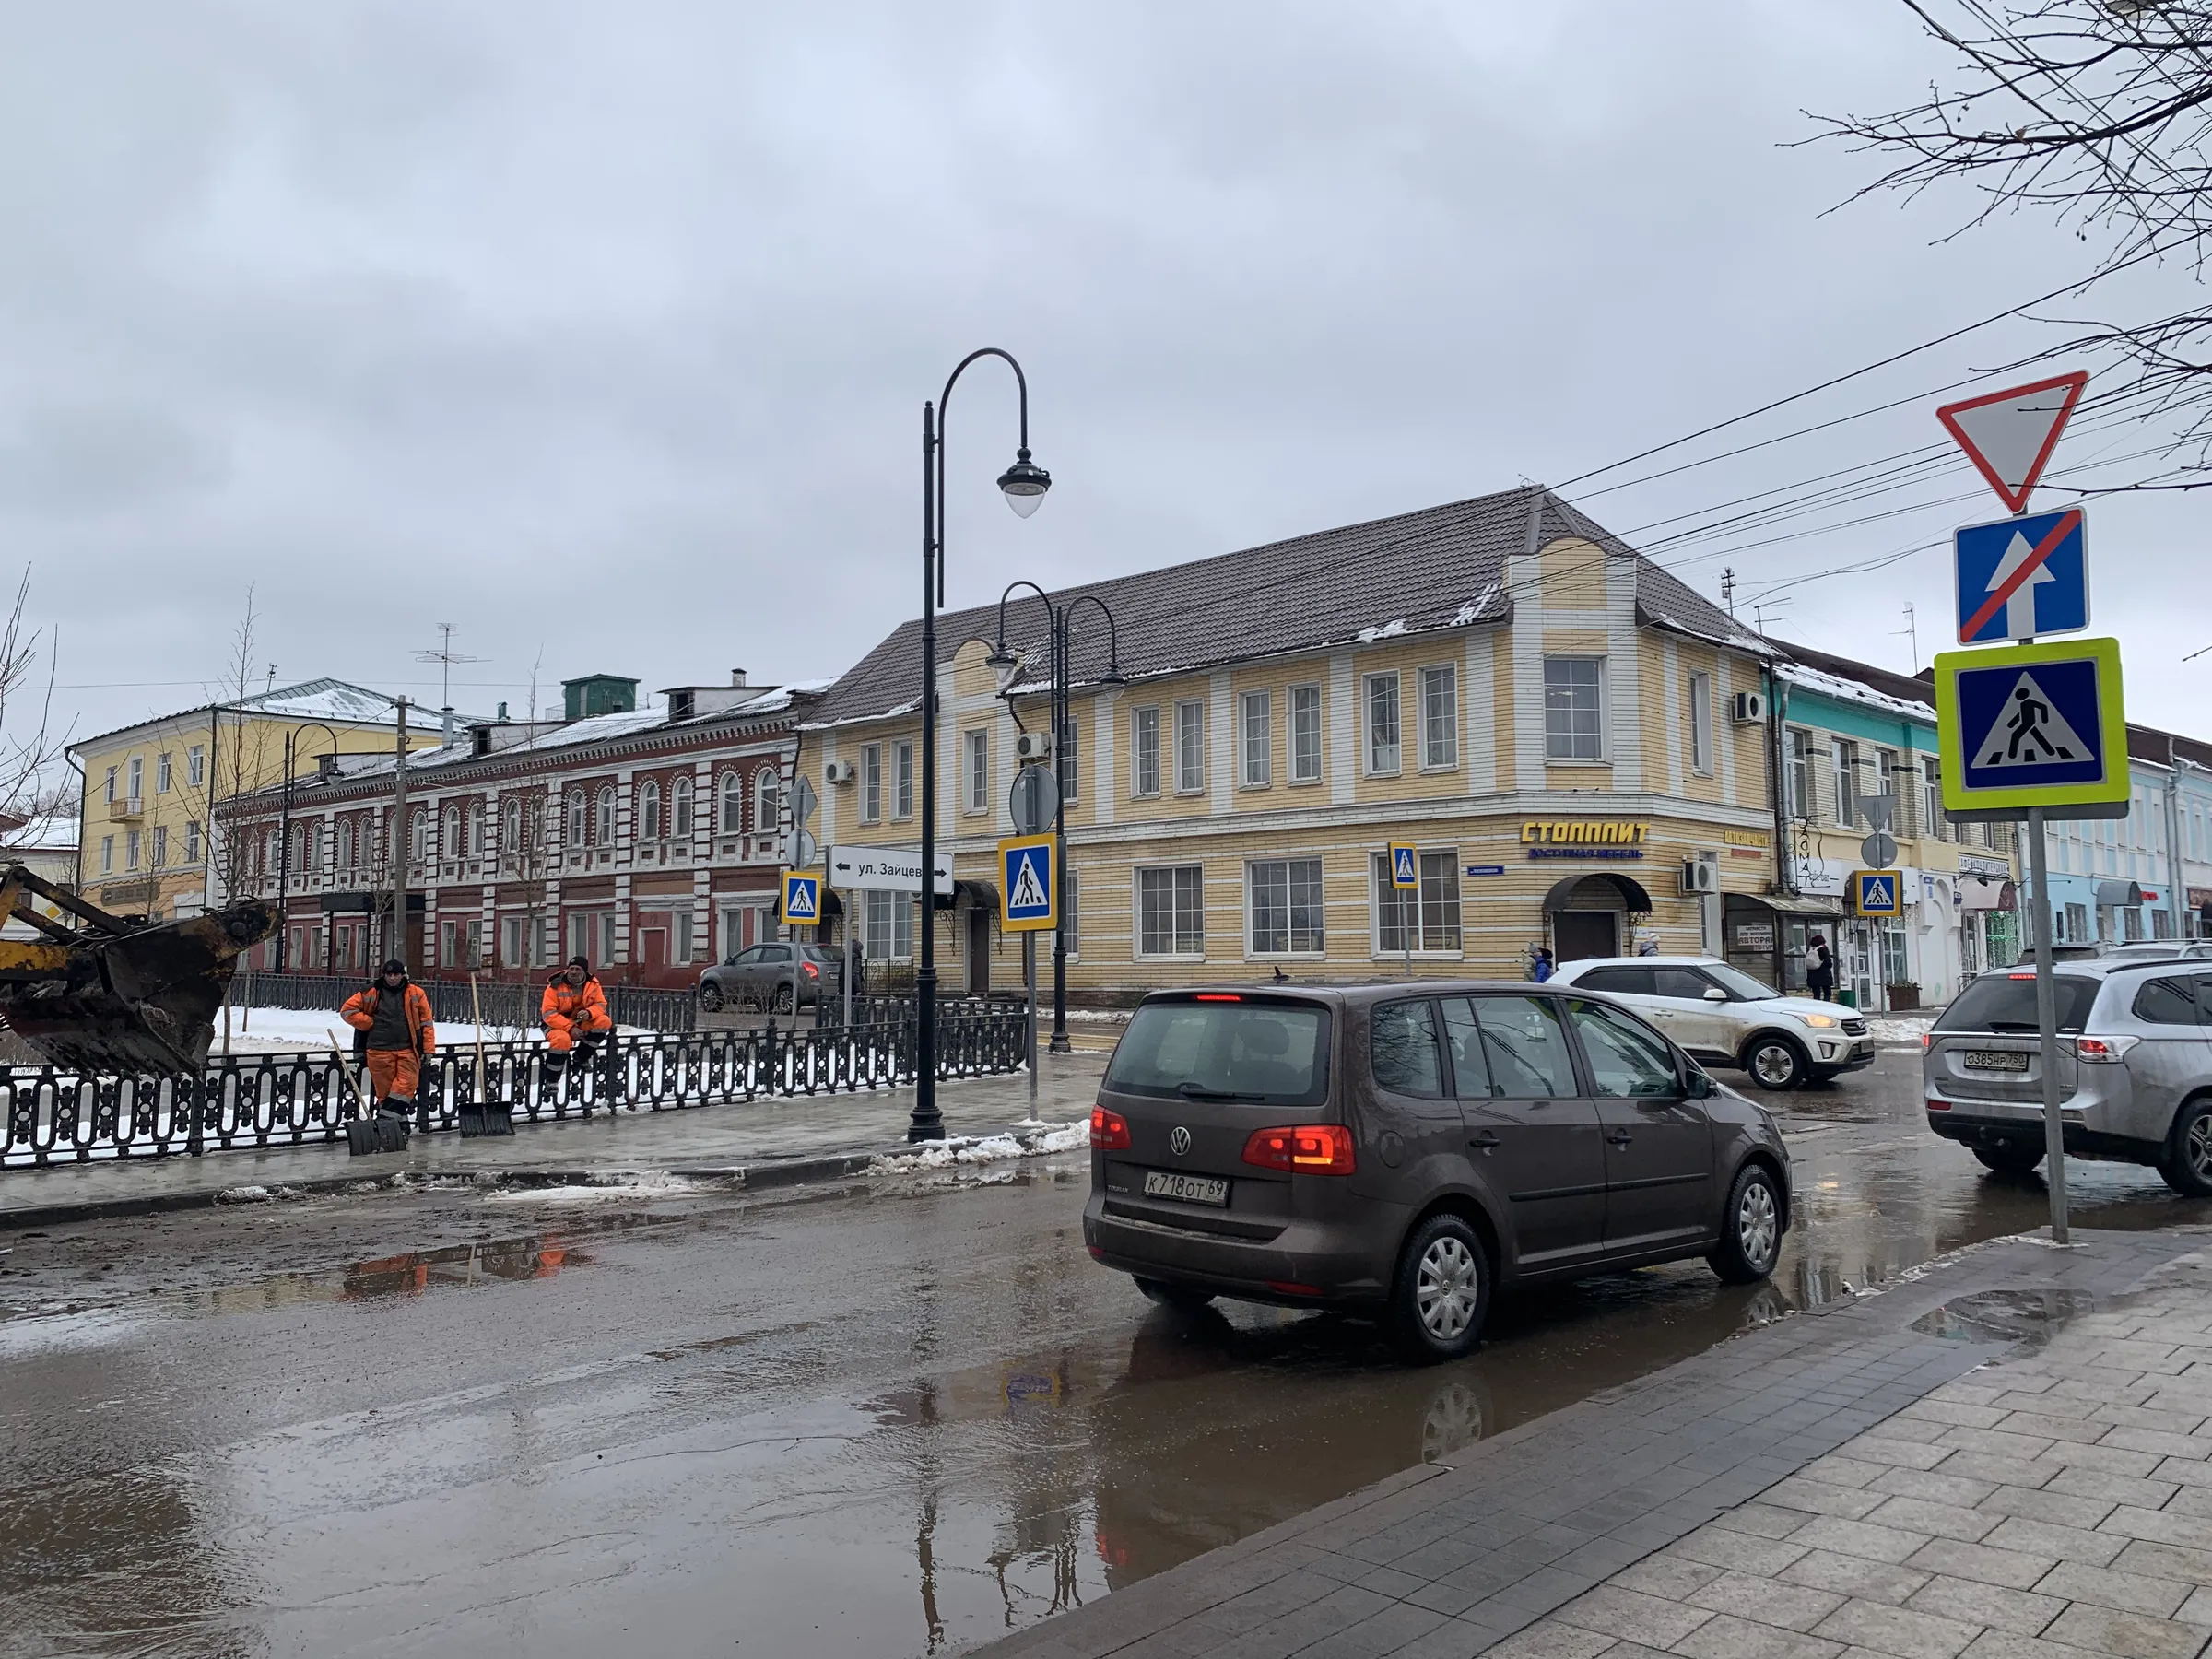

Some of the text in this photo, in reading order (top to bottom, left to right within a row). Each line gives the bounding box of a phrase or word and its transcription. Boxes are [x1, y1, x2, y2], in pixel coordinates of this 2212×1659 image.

[1522, 821, 1650, 843] СТОЛПЛИТ
[858, 863, 922, 878] ул. Зайцев
[1207, 1180, 1224, 1196] 69
